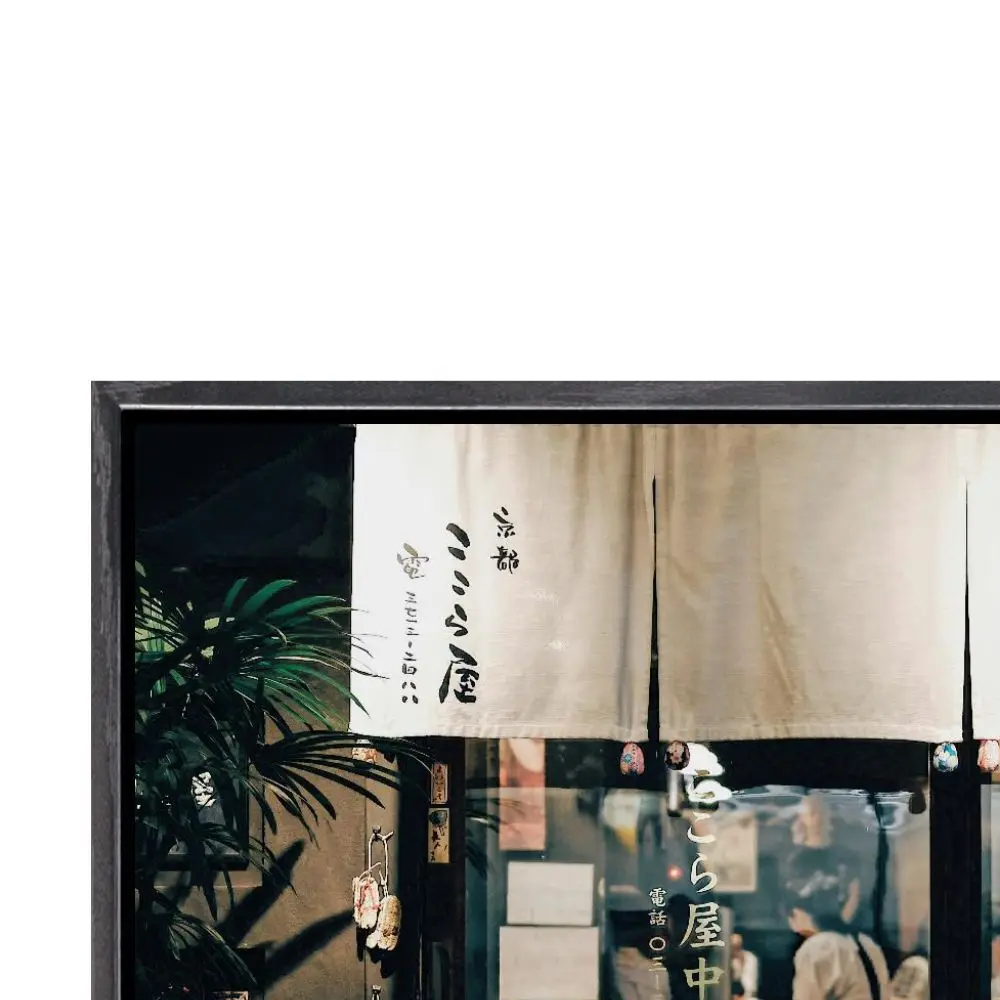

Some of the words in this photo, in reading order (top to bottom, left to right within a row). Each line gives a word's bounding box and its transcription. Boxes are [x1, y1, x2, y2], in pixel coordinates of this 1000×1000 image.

[490, 506, 520, 574] 京都
[438, 522, 480, 704] ここら屋
